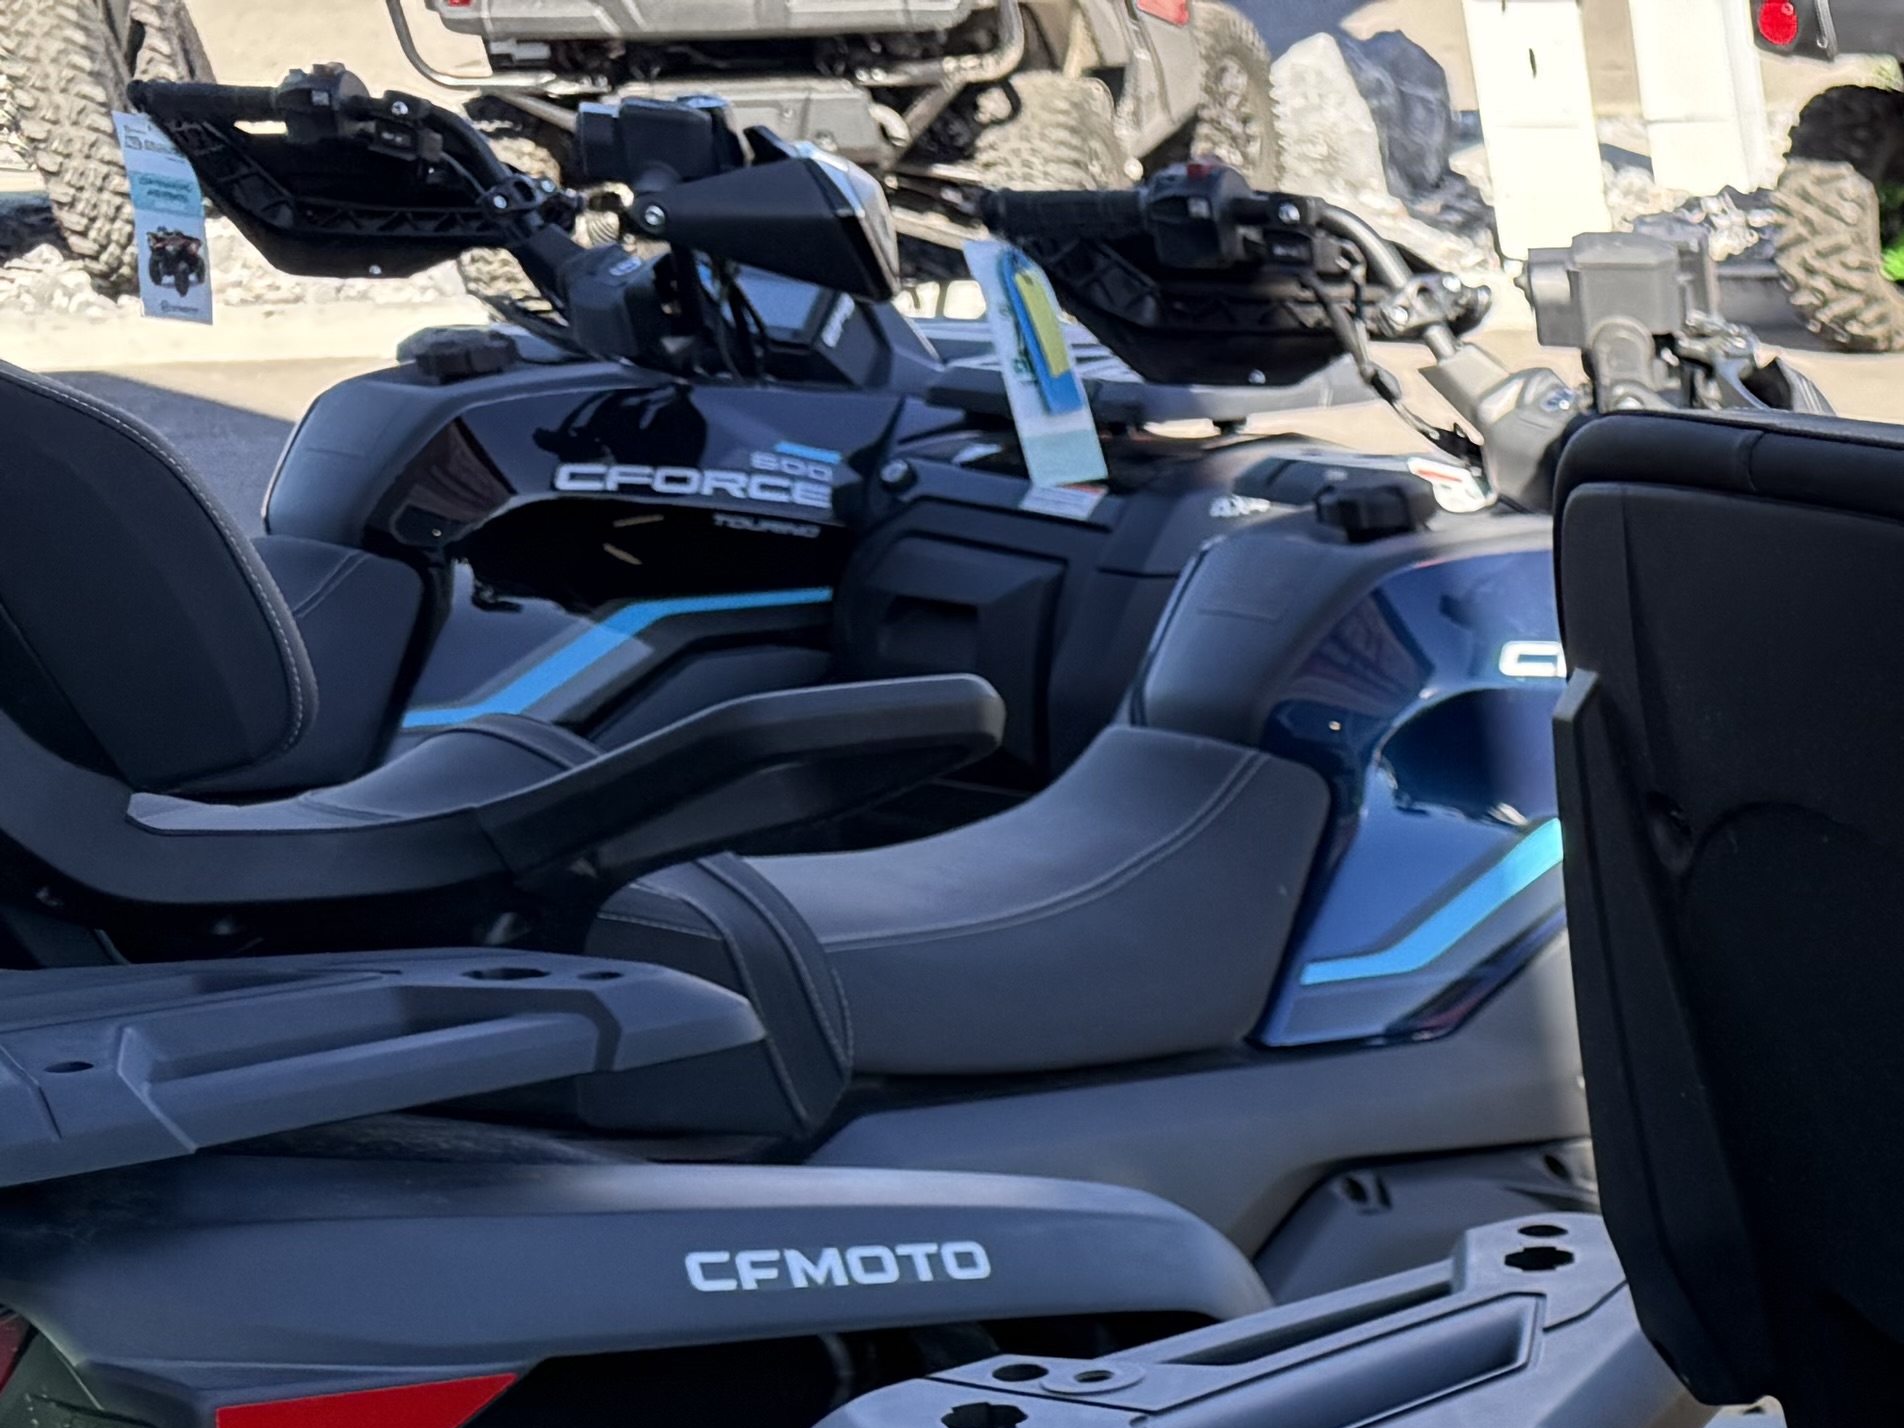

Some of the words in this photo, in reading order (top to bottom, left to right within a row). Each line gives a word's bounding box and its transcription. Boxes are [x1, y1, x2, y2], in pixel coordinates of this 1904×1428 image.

[554, 462, 832, 509] CFORCE
[751, 451, 833, 482] 600
[712, 513, 822, 538] TOURING
[685, 1241, 992, 1292] CFMOTO
